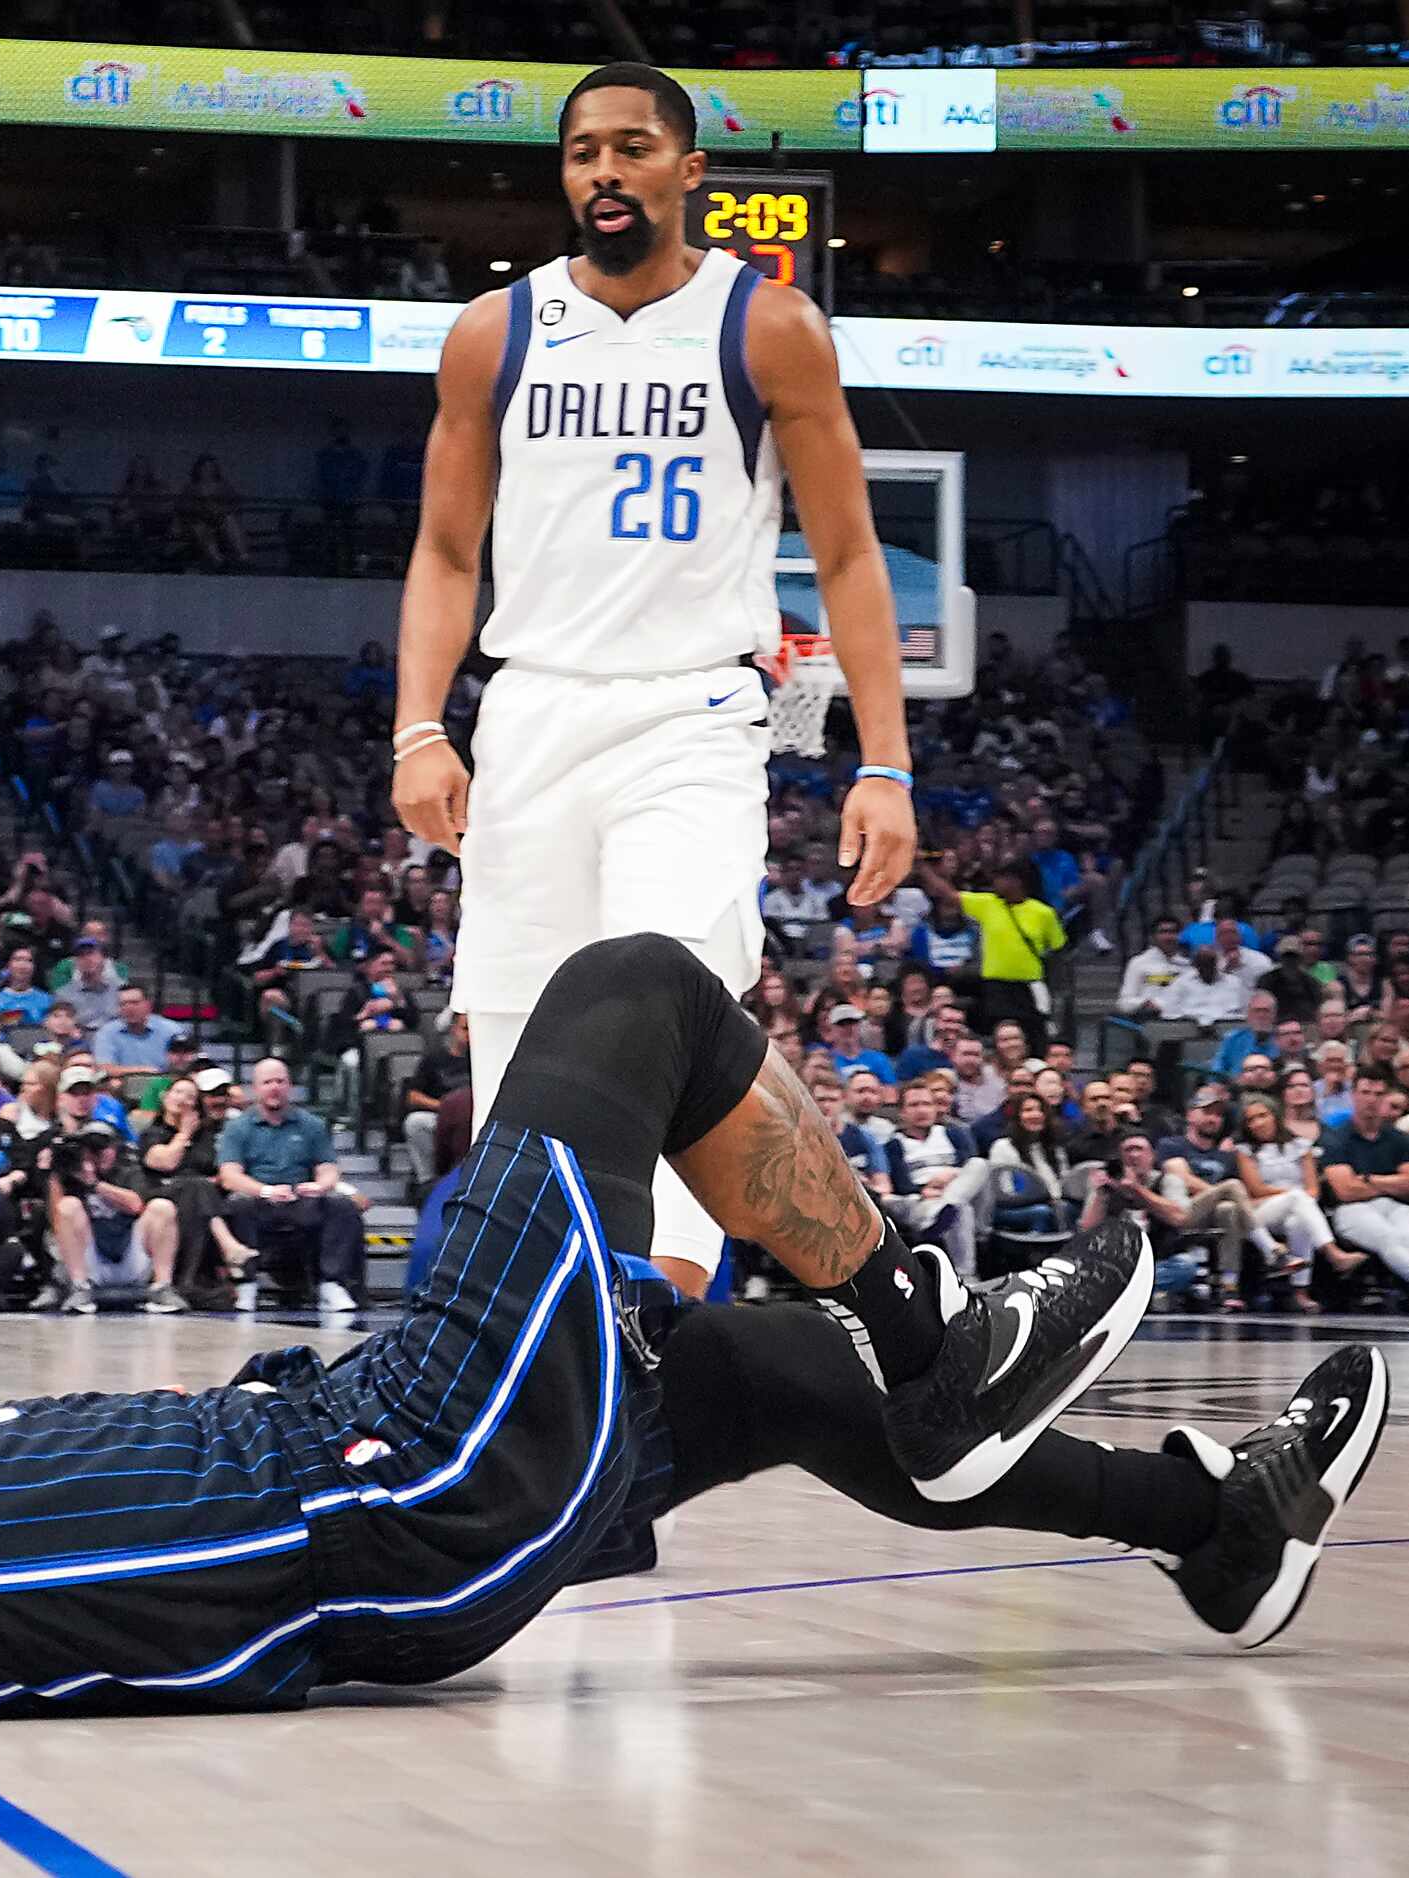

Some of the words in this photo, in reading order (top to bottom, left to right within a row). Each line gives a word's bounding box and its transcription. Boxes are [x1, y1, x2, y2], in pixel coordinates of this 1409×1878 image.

[704, 191, 809, 241] 2:09
[202, 326, 228, 357] 2
[896, 342, 944, 367] citi
[1204, 350, 1253, 375] citi
[526, 382, 710, 439] DALLAS
[609, 452, 705, 543] 26
